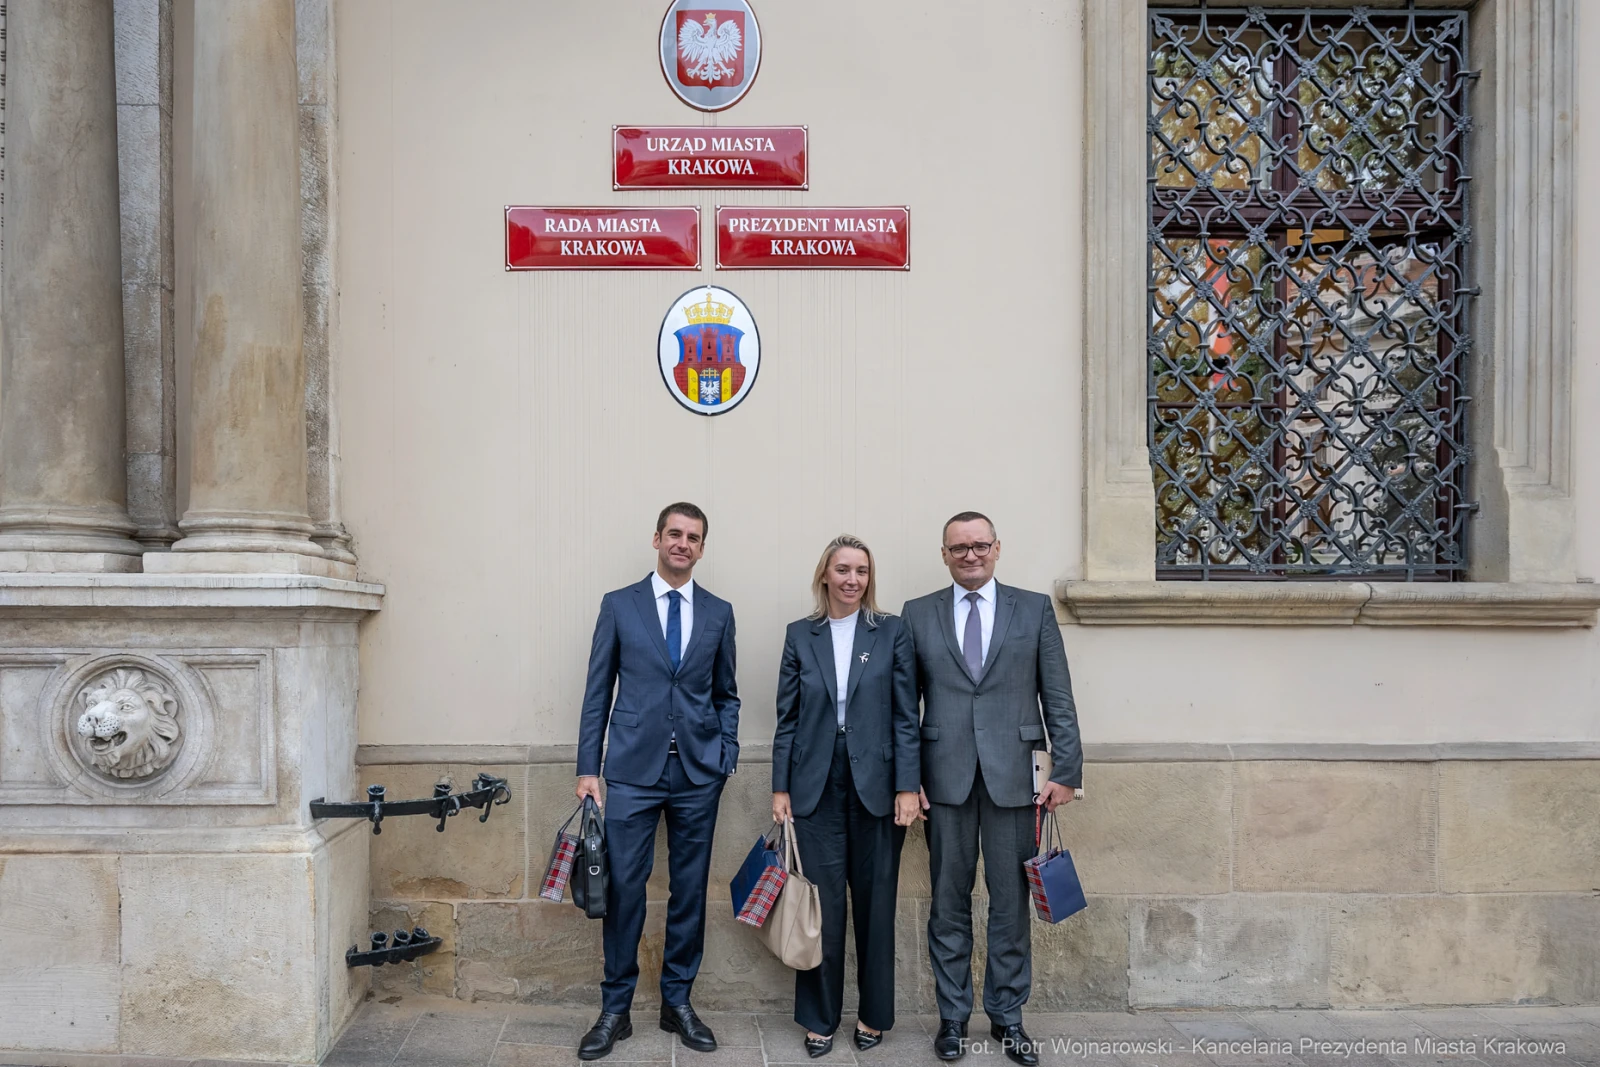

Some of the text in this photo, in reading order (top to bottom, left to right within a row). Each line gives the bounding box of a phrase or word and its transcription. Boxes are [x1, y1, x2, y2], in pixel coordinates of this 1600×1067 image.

[646, 137, 776, 156] URZĄD MIASTA
[667, 158, 755, 175] KRAKOWA
[544, 218, 662, 233] RADA MIASTA
[728, 217, 898, 234] PREZYDENT MIASTA
[560, 239, 647, 256] KRAKOWA
[770, 239, 857, 255] KRAKOWA
